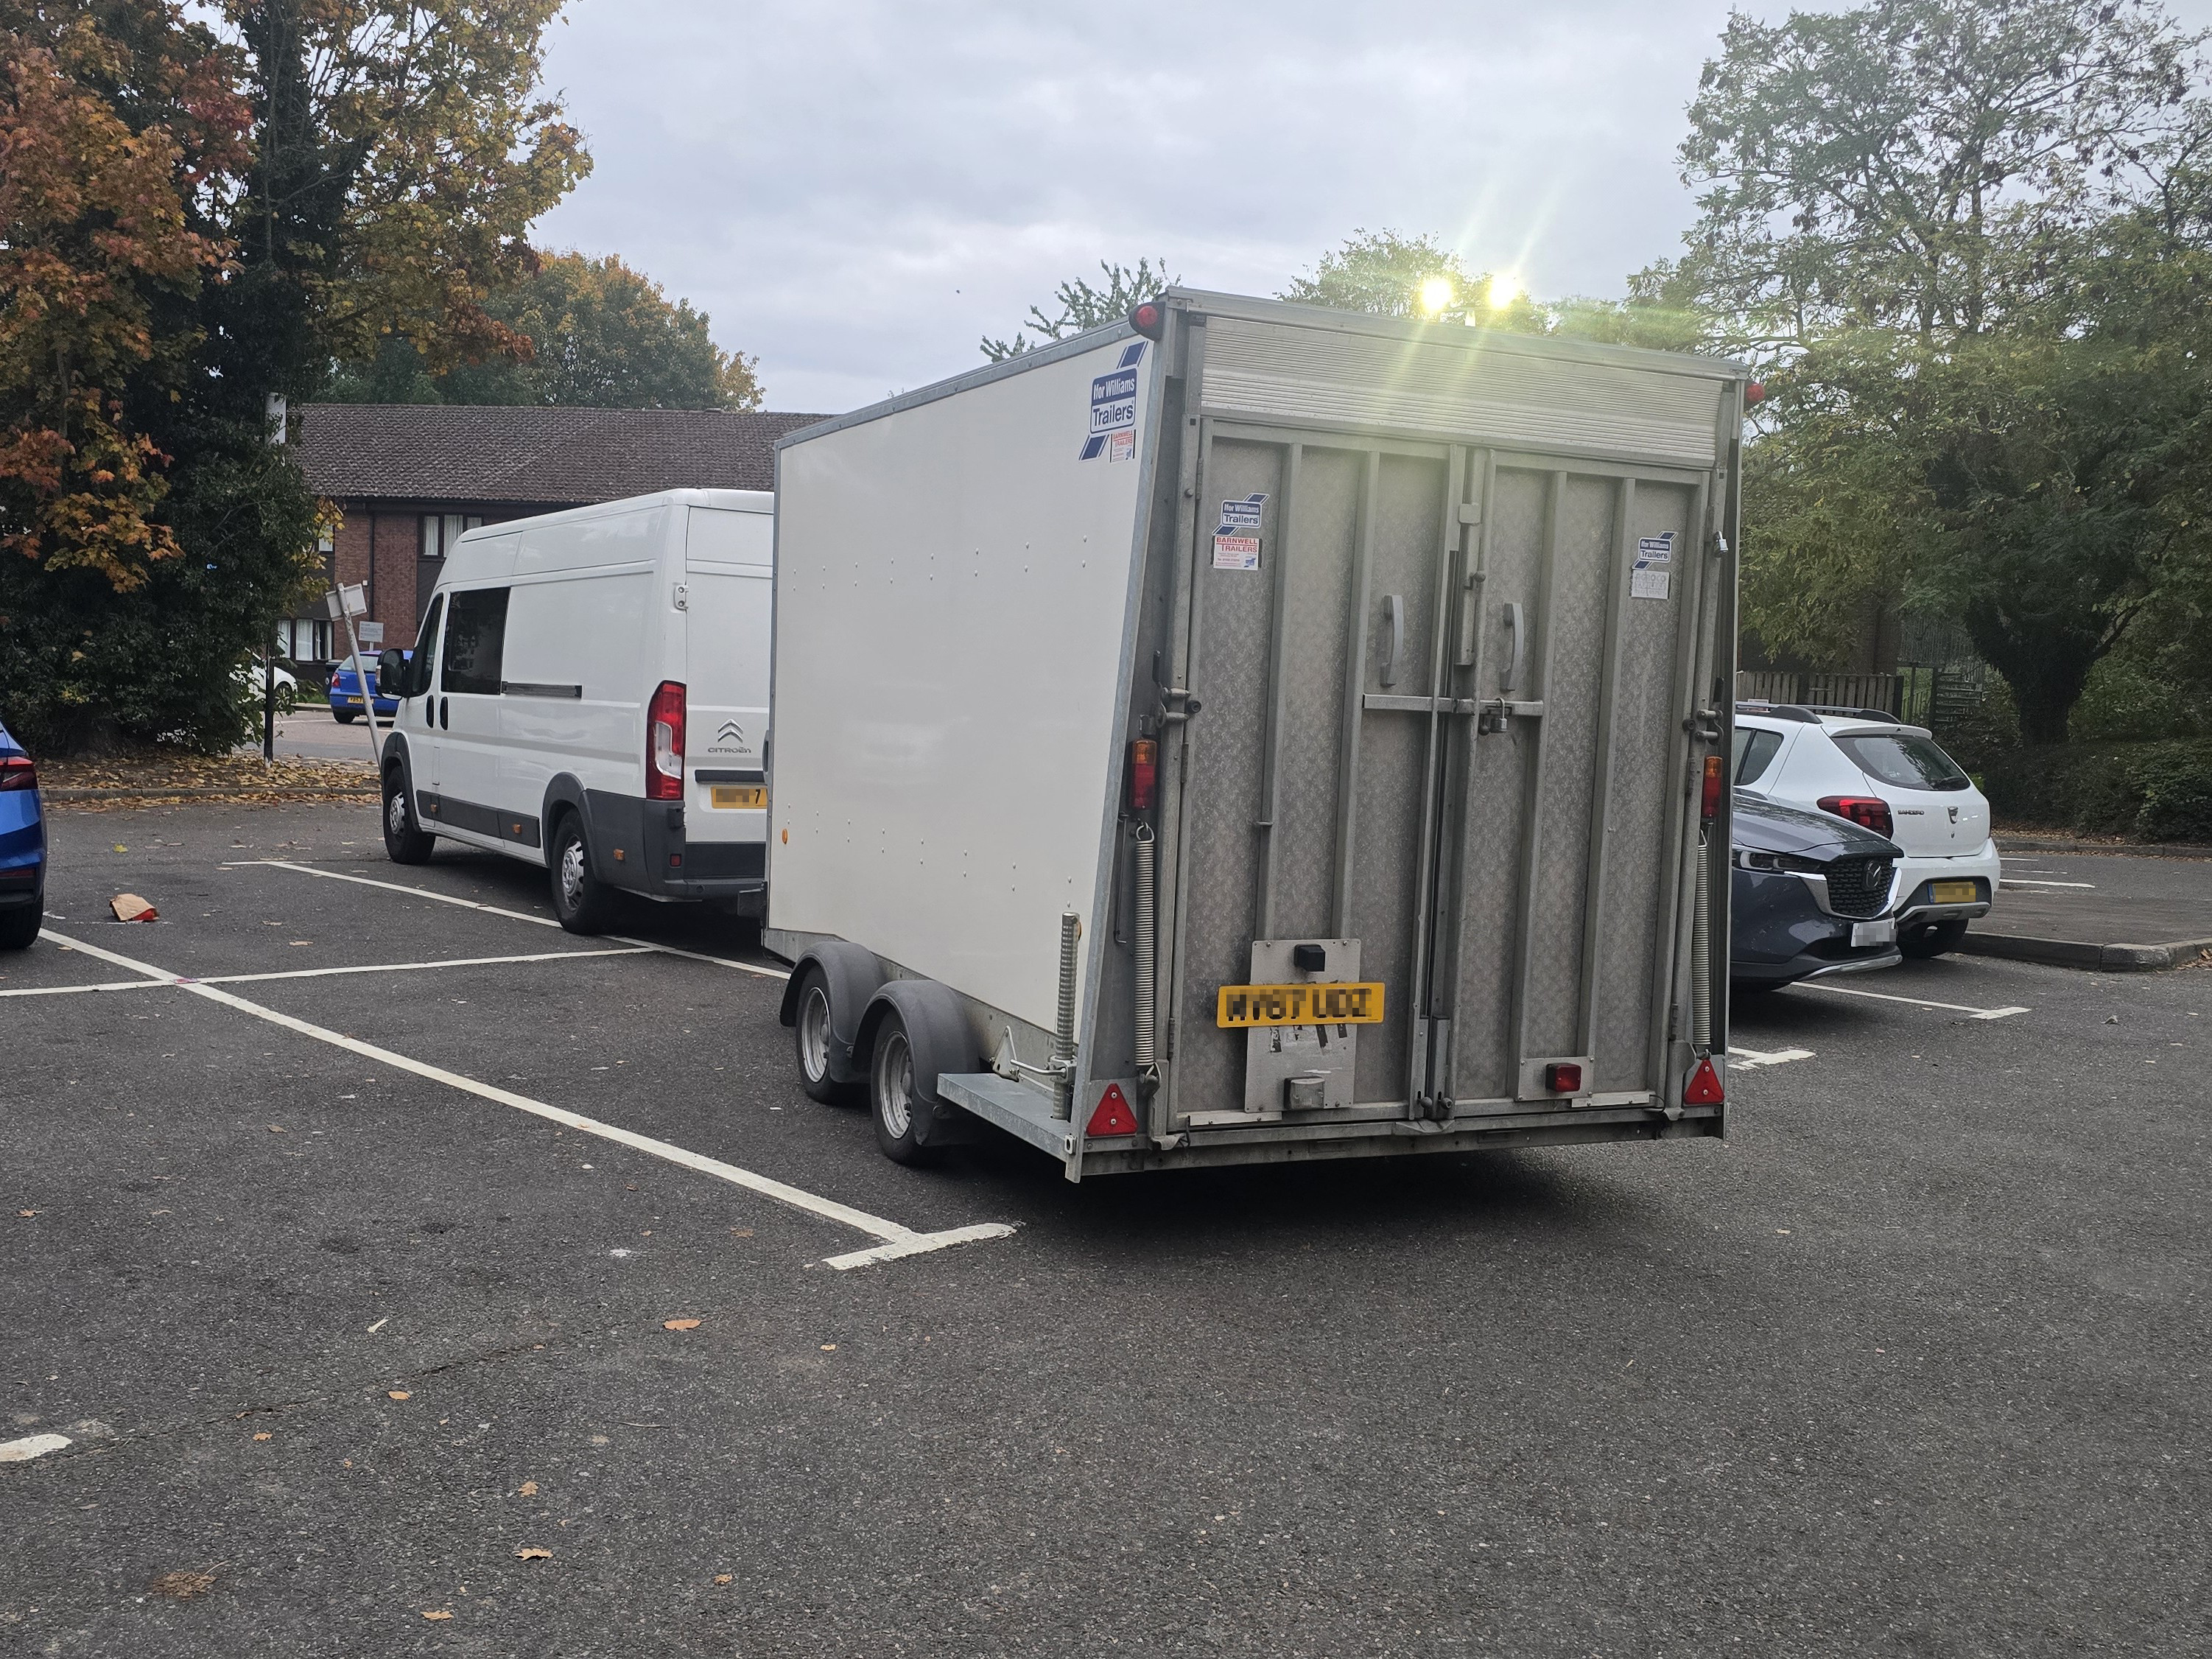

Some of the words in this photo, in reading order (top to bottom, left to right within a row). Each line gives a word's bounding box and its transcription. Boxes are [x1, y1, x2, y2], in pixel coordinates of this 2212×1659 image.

[1093, 383, 1105, 400] Ifor
[1106, 378, 1135, 397] Williams
[1093, 404, 1134, 426] Trailers
[1235, 505, 1259, 513] Williams
[1224, 514, 1258, 524] Trailers
[1221, 544, 1257, 553] TRAILERS
